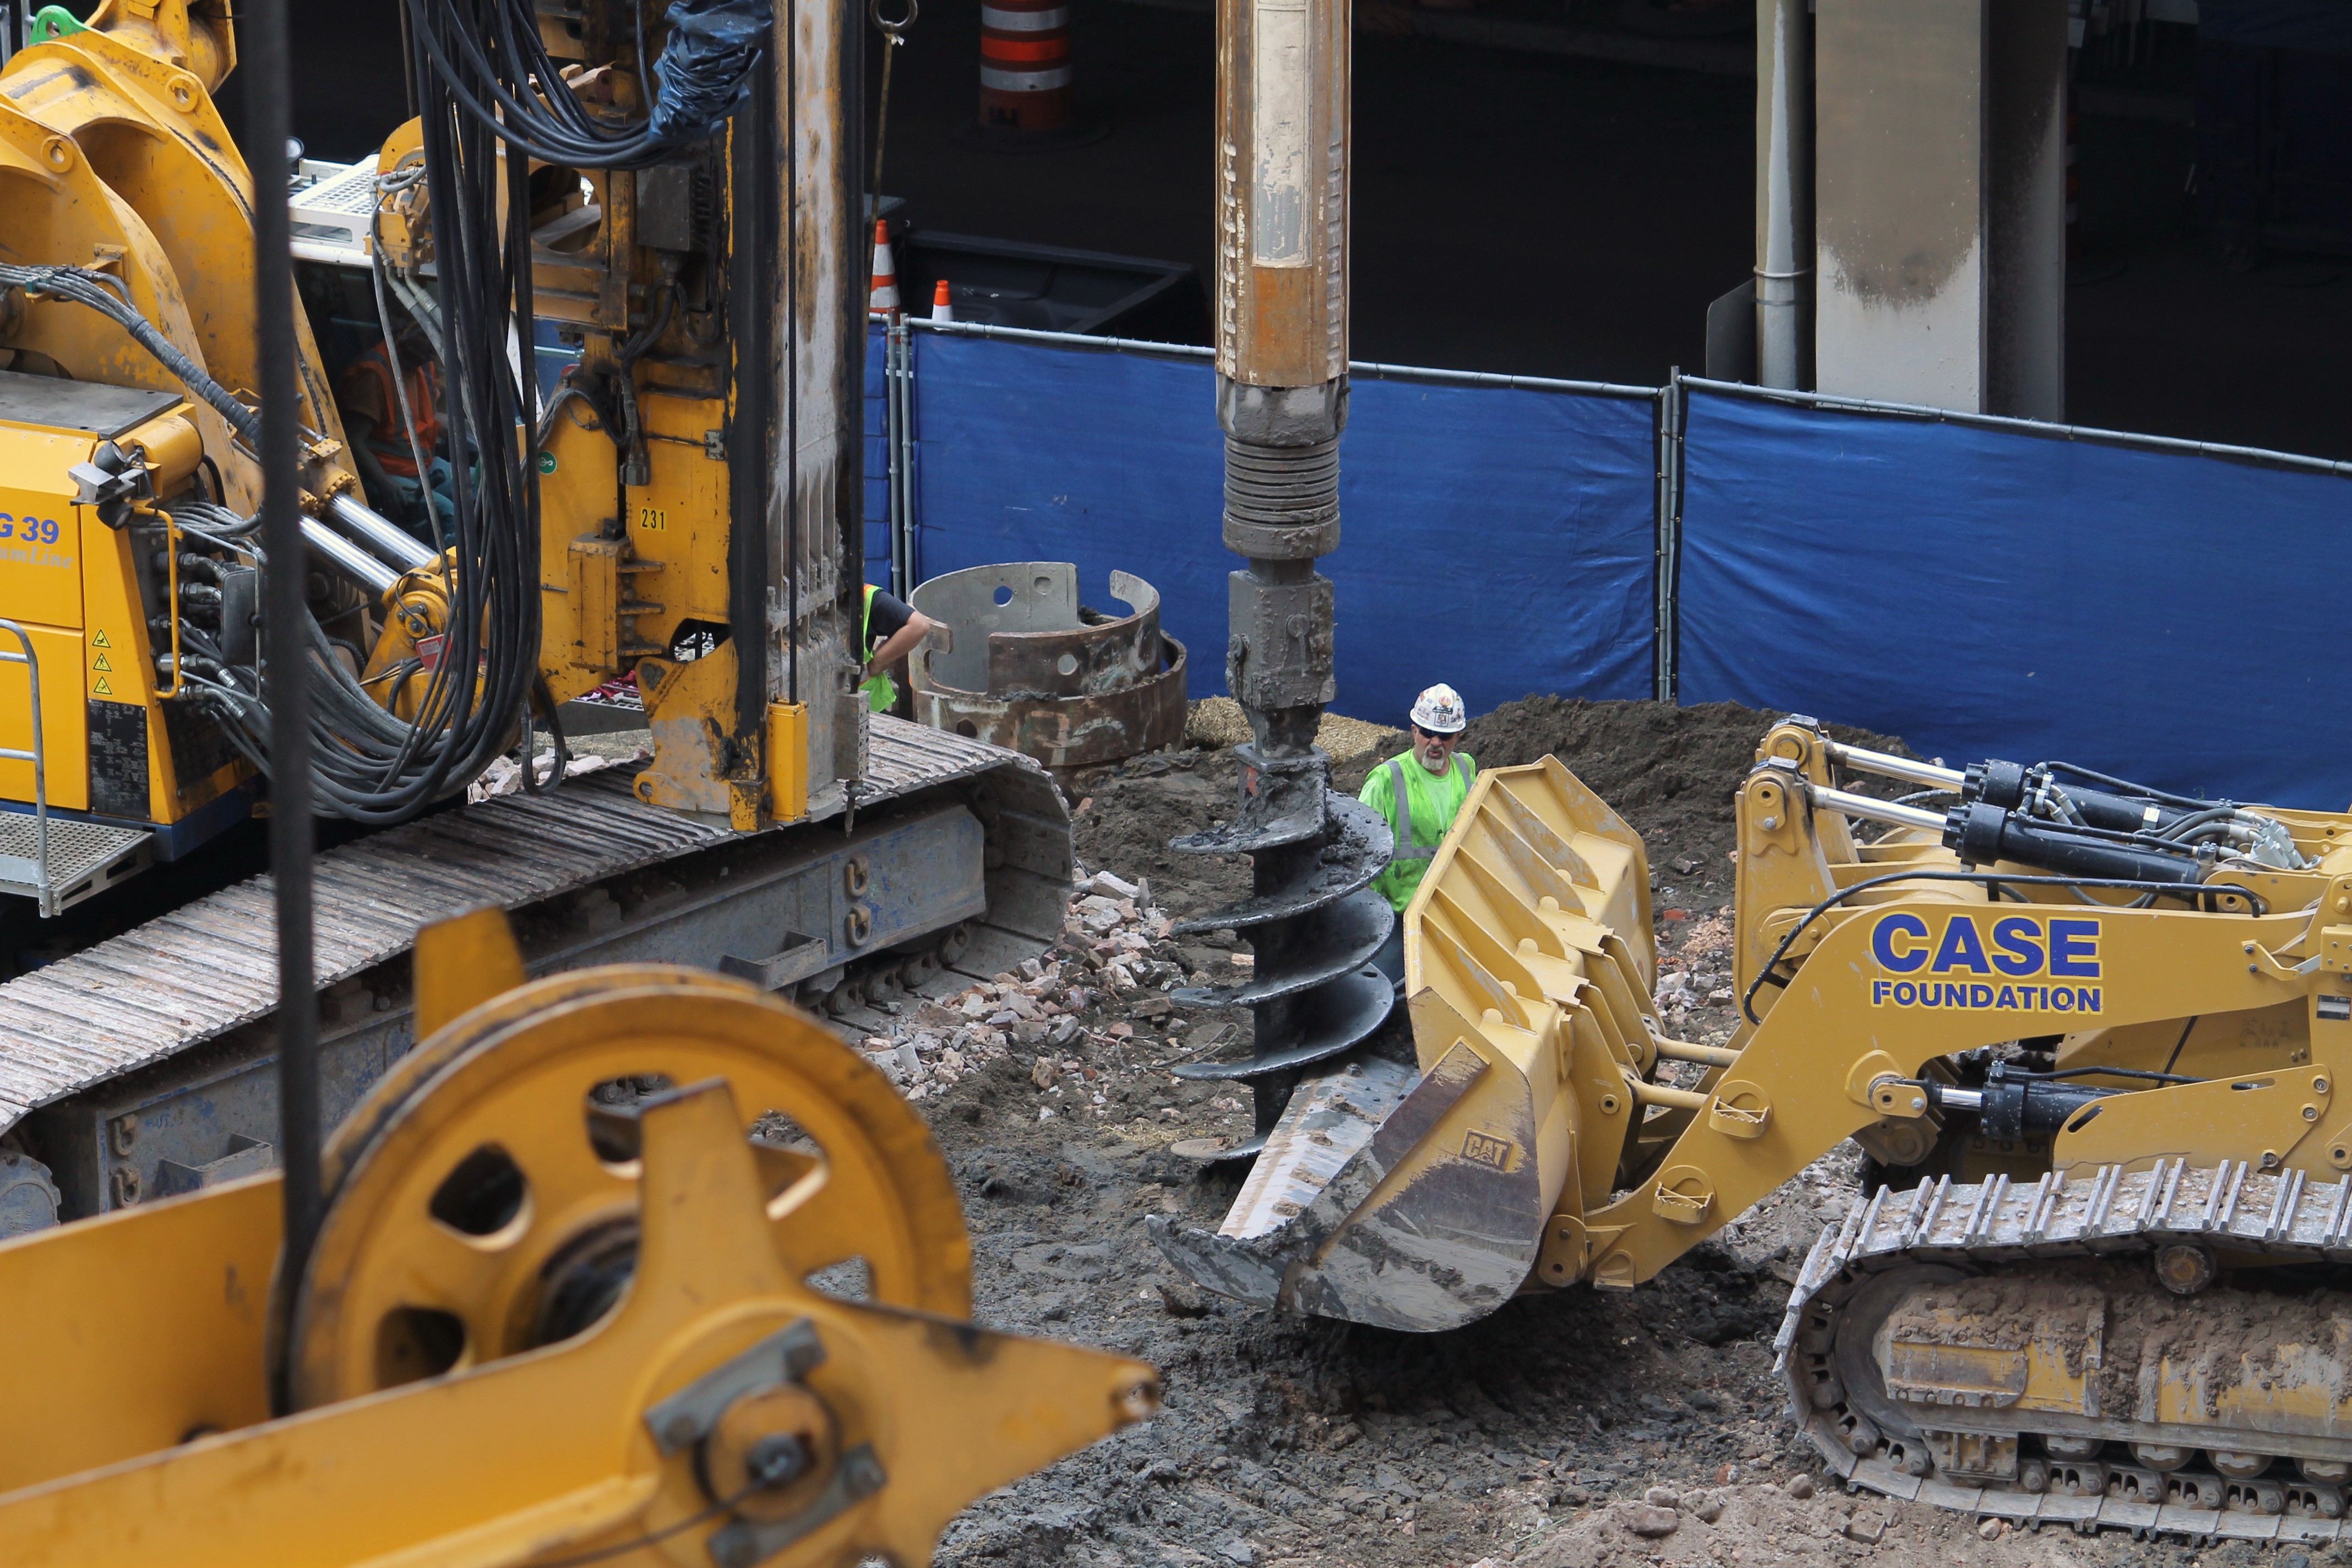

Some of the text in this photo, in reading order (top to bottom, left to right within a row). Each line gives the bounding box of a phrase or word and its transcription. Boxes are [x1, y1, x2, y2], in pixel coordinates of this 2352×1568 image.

[20, 516, 59, 545] 39
[642, 508, 664, 530] 231
[1871, 912, 2101, 979] CASE
[1872, 981, 2101, 1013] FOUNDATION
[1464, 1134, 1507, 1167] CAT
